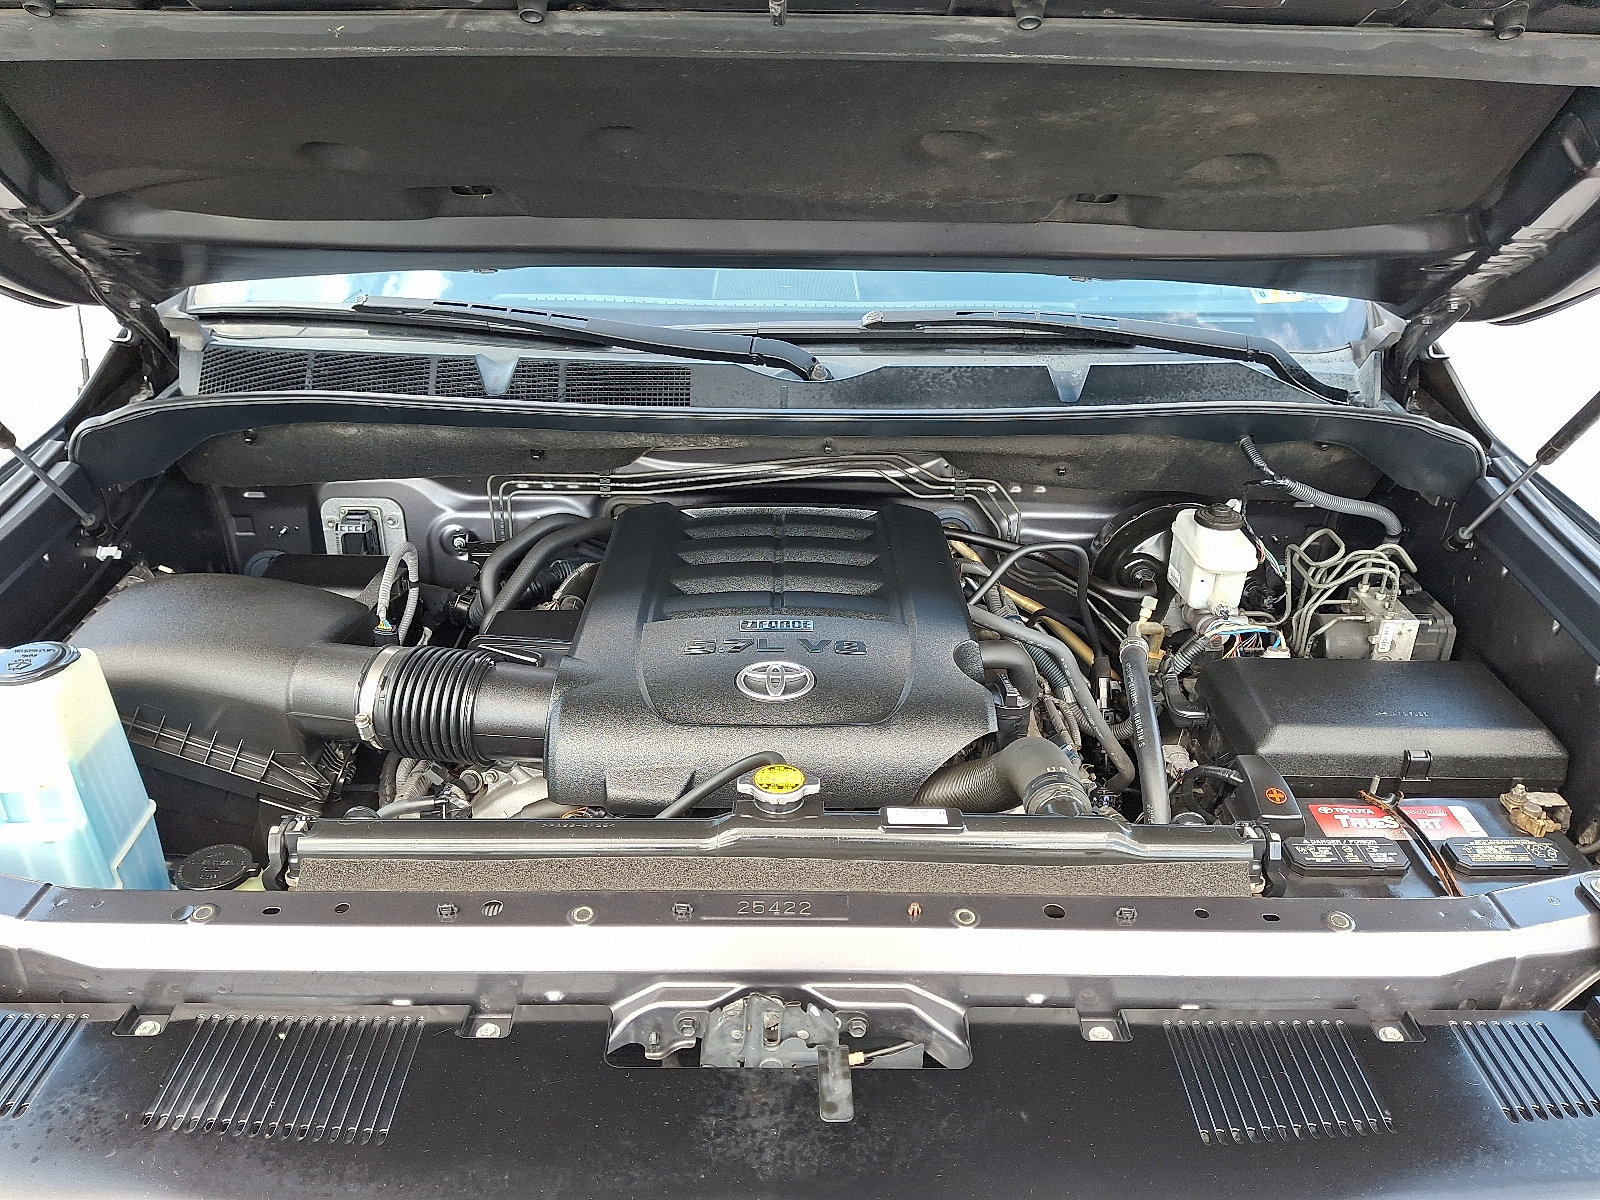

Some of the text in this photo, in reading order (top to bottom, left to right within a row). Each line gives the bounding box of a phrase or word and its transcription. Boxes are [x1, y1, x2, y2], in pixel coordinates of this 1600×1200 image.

[798, 638, 868, 655] V8
[1332, 807, 1375, 815] TOYOTA
[737, 900, 812, 916] 25422
